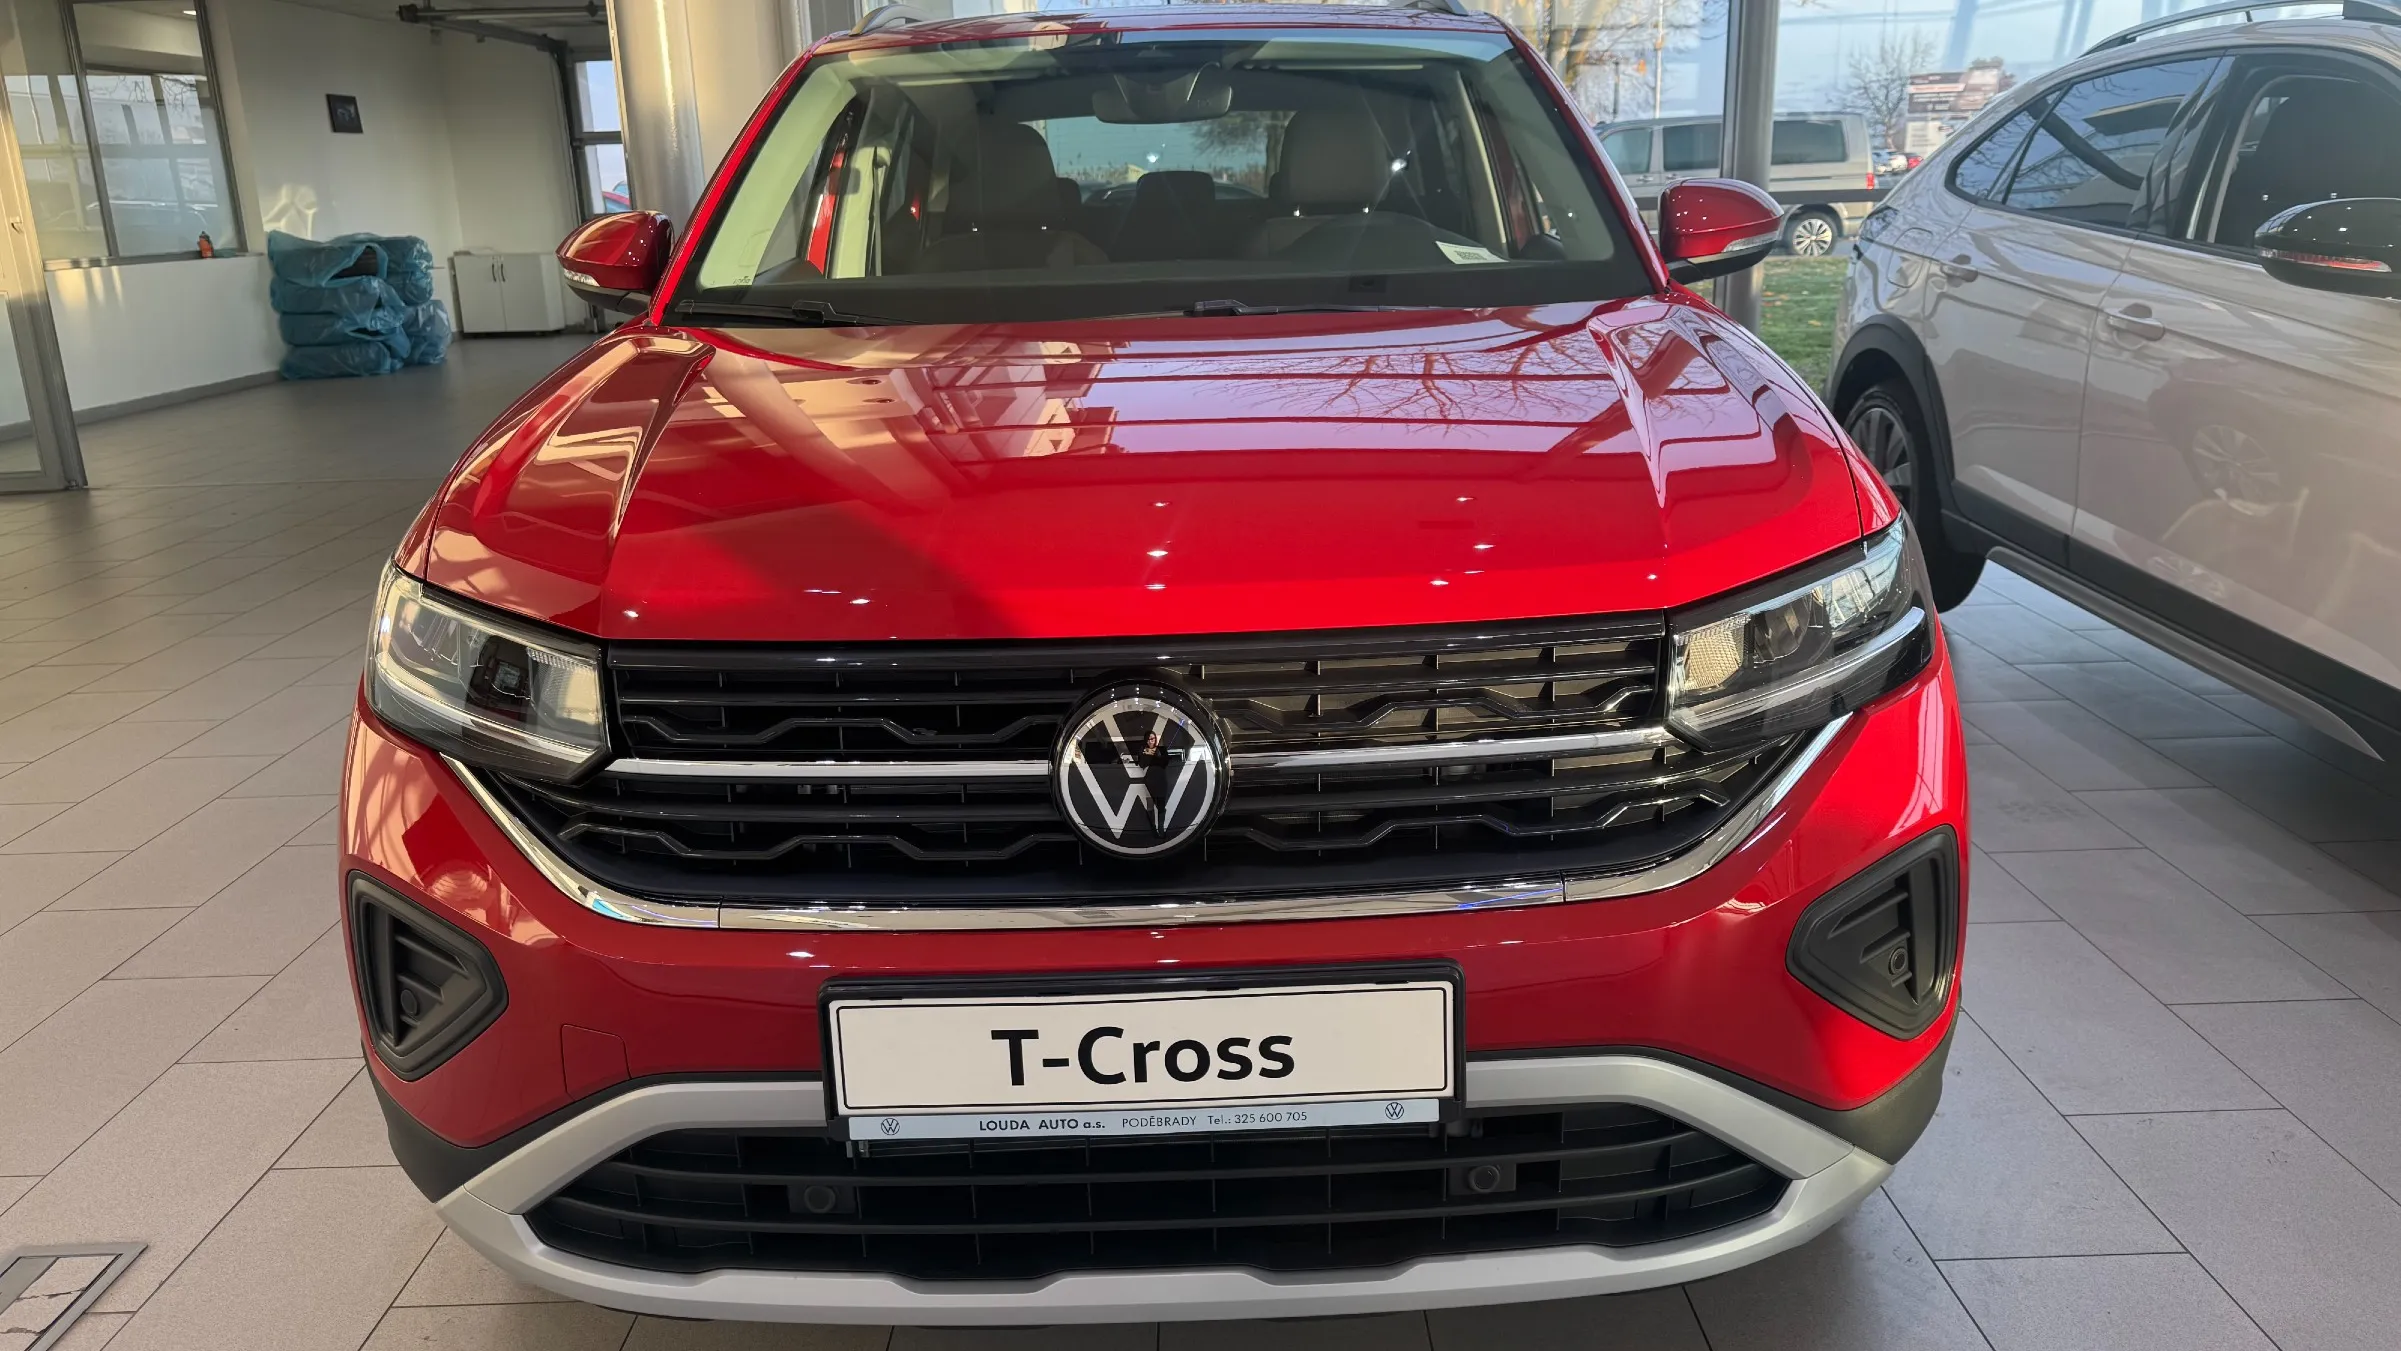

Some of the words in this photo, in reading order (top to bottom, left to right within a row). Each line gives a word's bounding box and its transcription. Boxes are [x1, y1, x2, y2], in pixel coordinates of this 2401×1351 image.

[1060, 698, 1216, 854] VW
[990, 1026, 1295, 1087] T-Cross
[979, 1119, 1031, 1132] LOUDA
[1038, 1118, 1079, 1130] AUTO
[1082, 1121, 1106, 1129] a.s.
[1122, 1115, 1197, 1129] PODĚBRADY
[1207, 1113, 1232, 1125] Tel.:
[1234, 1113, 1256, 1124] 325
[1259, 1112, 1283, 1123] 600
[1286, 1111, 1308, 1122] 705
